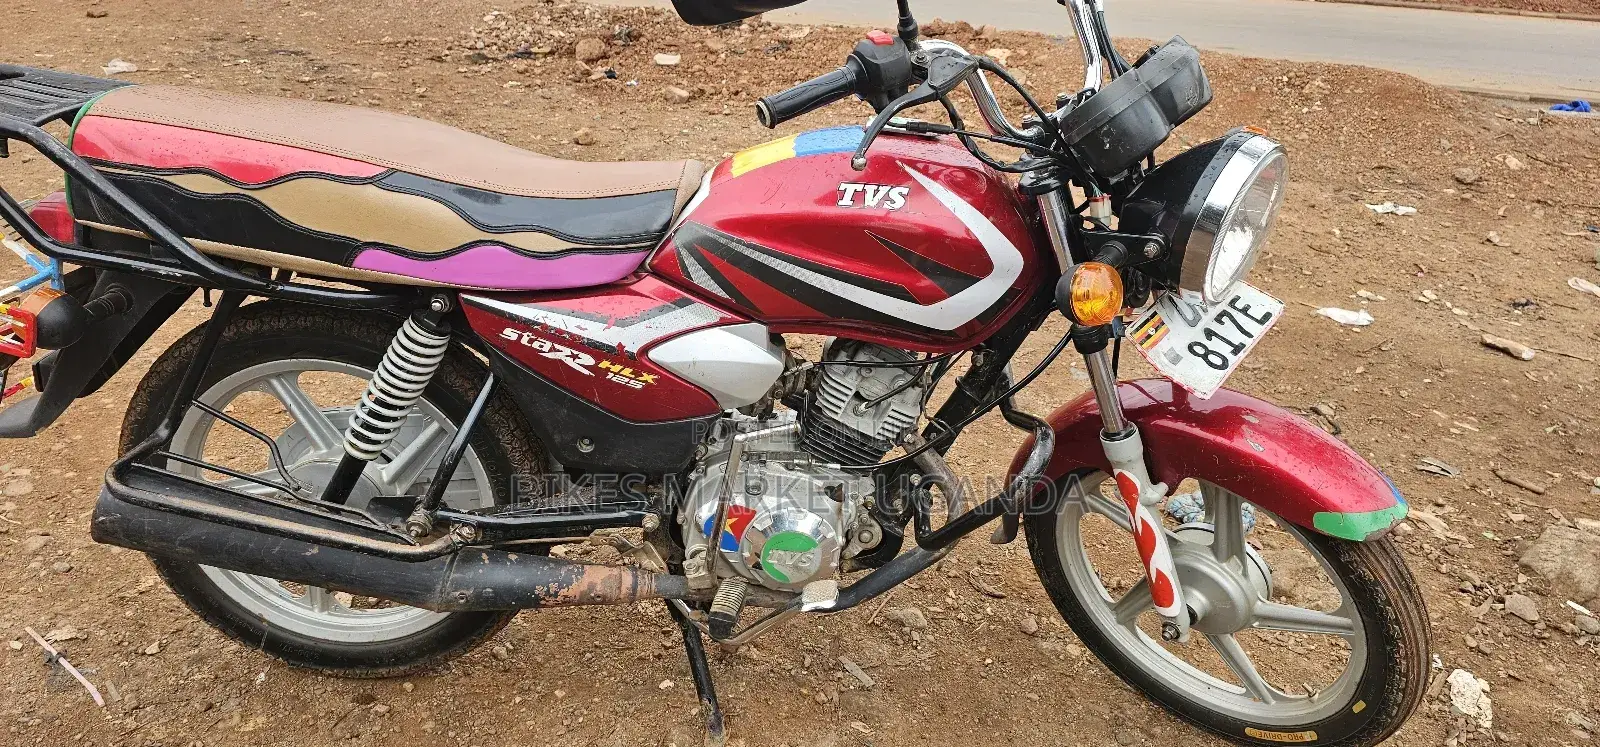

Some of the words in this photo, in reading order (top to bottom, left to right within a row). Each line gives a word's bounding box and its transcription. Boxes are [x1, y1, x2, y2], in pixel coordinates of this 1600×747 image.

[837, 182, 910, 211] TVS
[1187, 294, 1273, 371] 817E
[598, 359, 660, 385] HLX
[605, 372, 646, 390] 125
[766, 550, 815, 567] TVS
